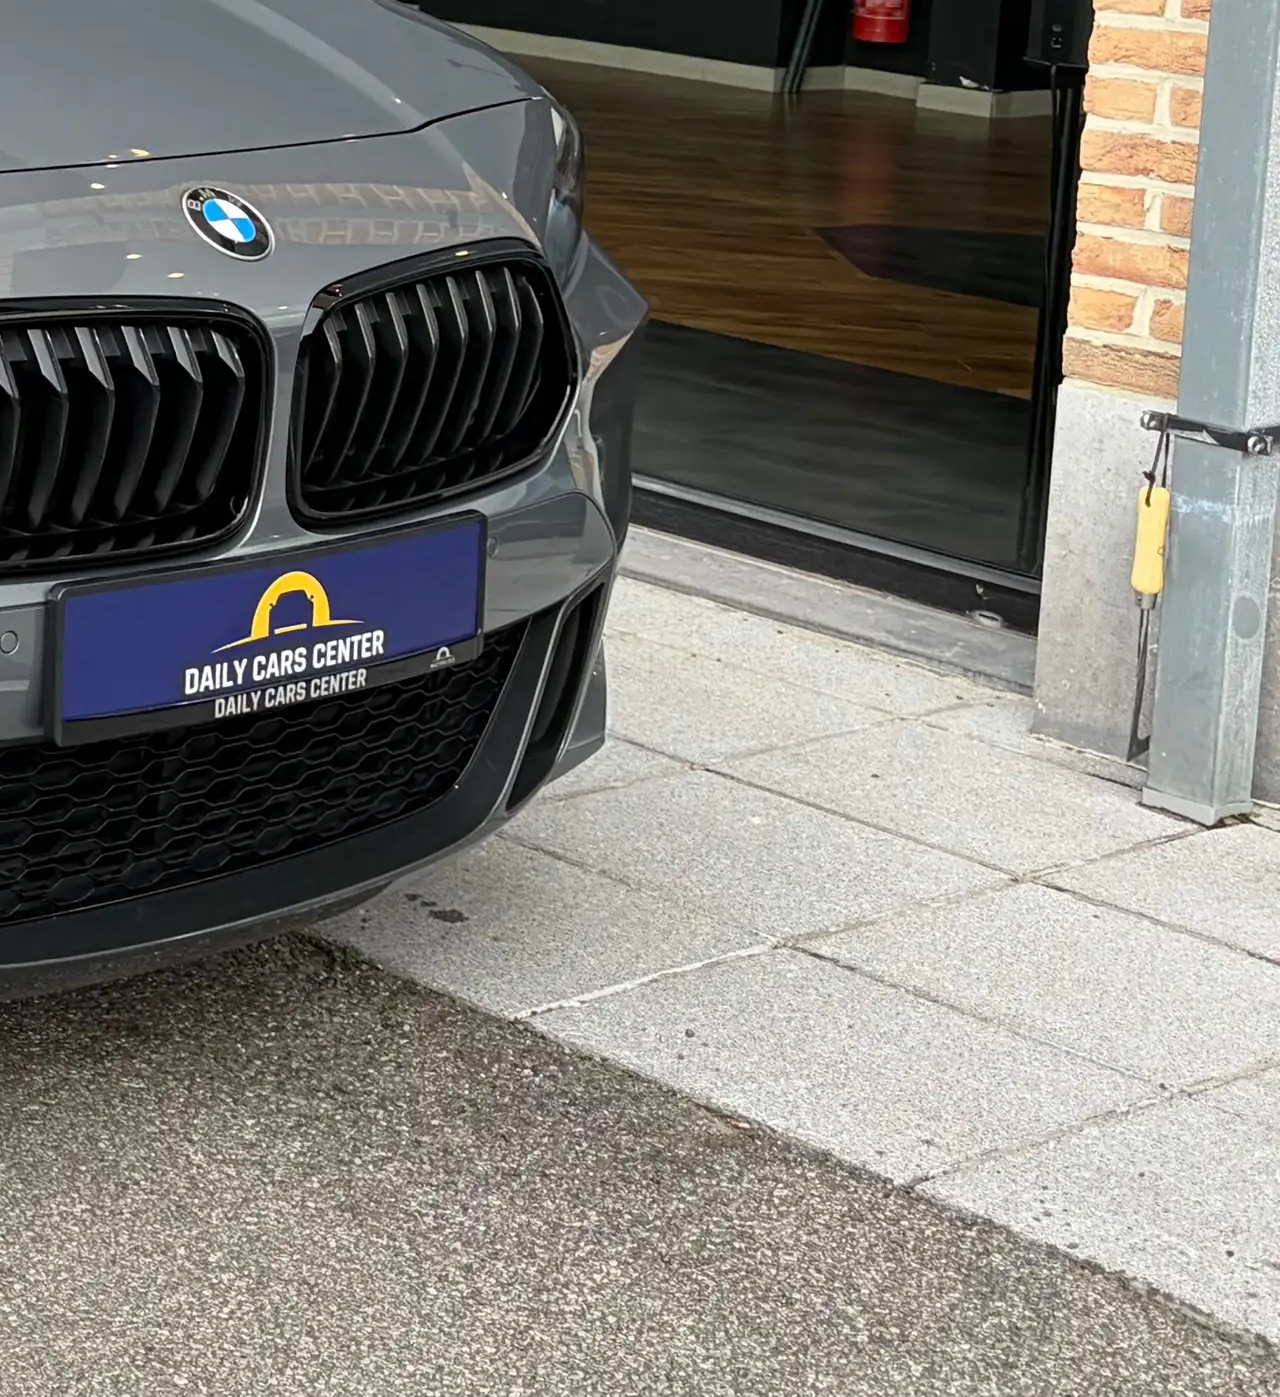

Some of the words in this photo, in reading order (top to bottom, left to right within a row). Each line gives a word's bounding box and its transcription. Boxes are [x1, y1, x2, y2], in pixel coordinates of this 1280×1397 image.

[185, 658, 247, 695] DAILY
[252, 647, 307, 681] CARS
[313, 630, 384, 668] CENTER
[215, 690, 261, 719] DAILY
[265, 681, 306, 708] CARS
[310, 669, 367, 698] CENTER
